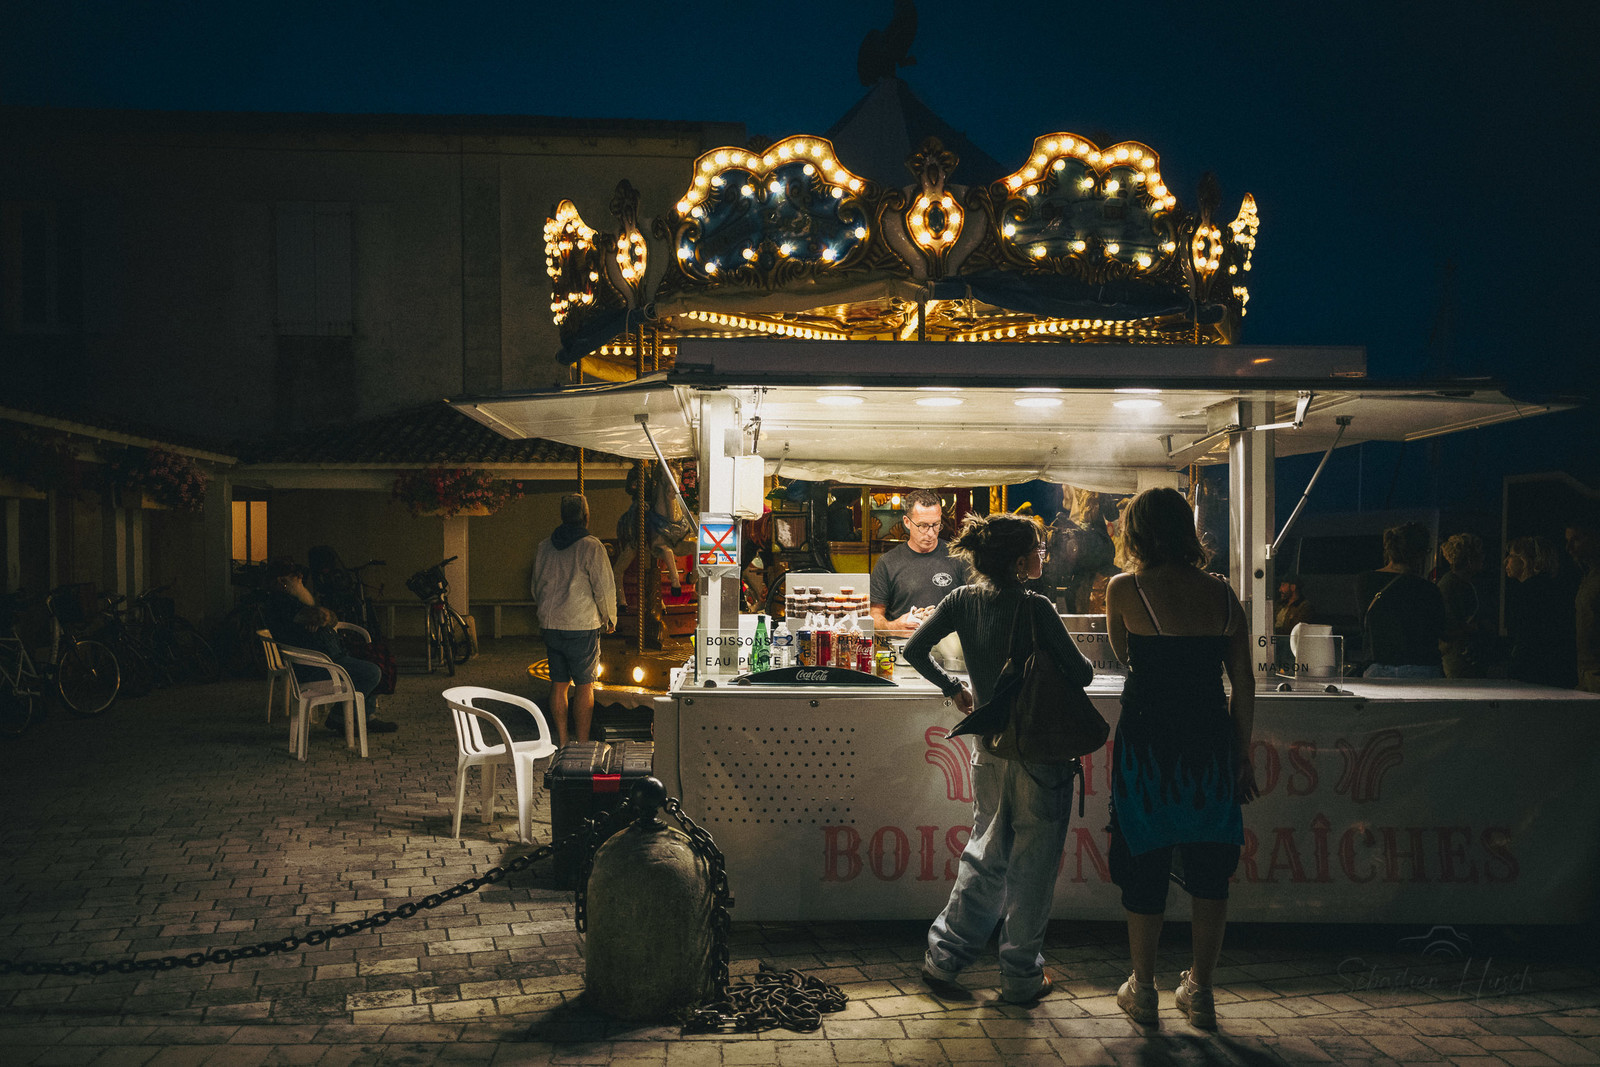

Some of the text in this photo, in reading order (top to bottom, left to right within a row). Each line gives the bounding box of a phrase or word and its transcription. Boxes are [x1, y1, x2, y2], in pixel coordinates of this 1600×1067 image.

[706, 636, 772, 647] BOISSONS
[705, 656, 731, 666] EAU
[738, 656, 781, 666] PLATE
[1258, 662, 1309, 672] MAISON
